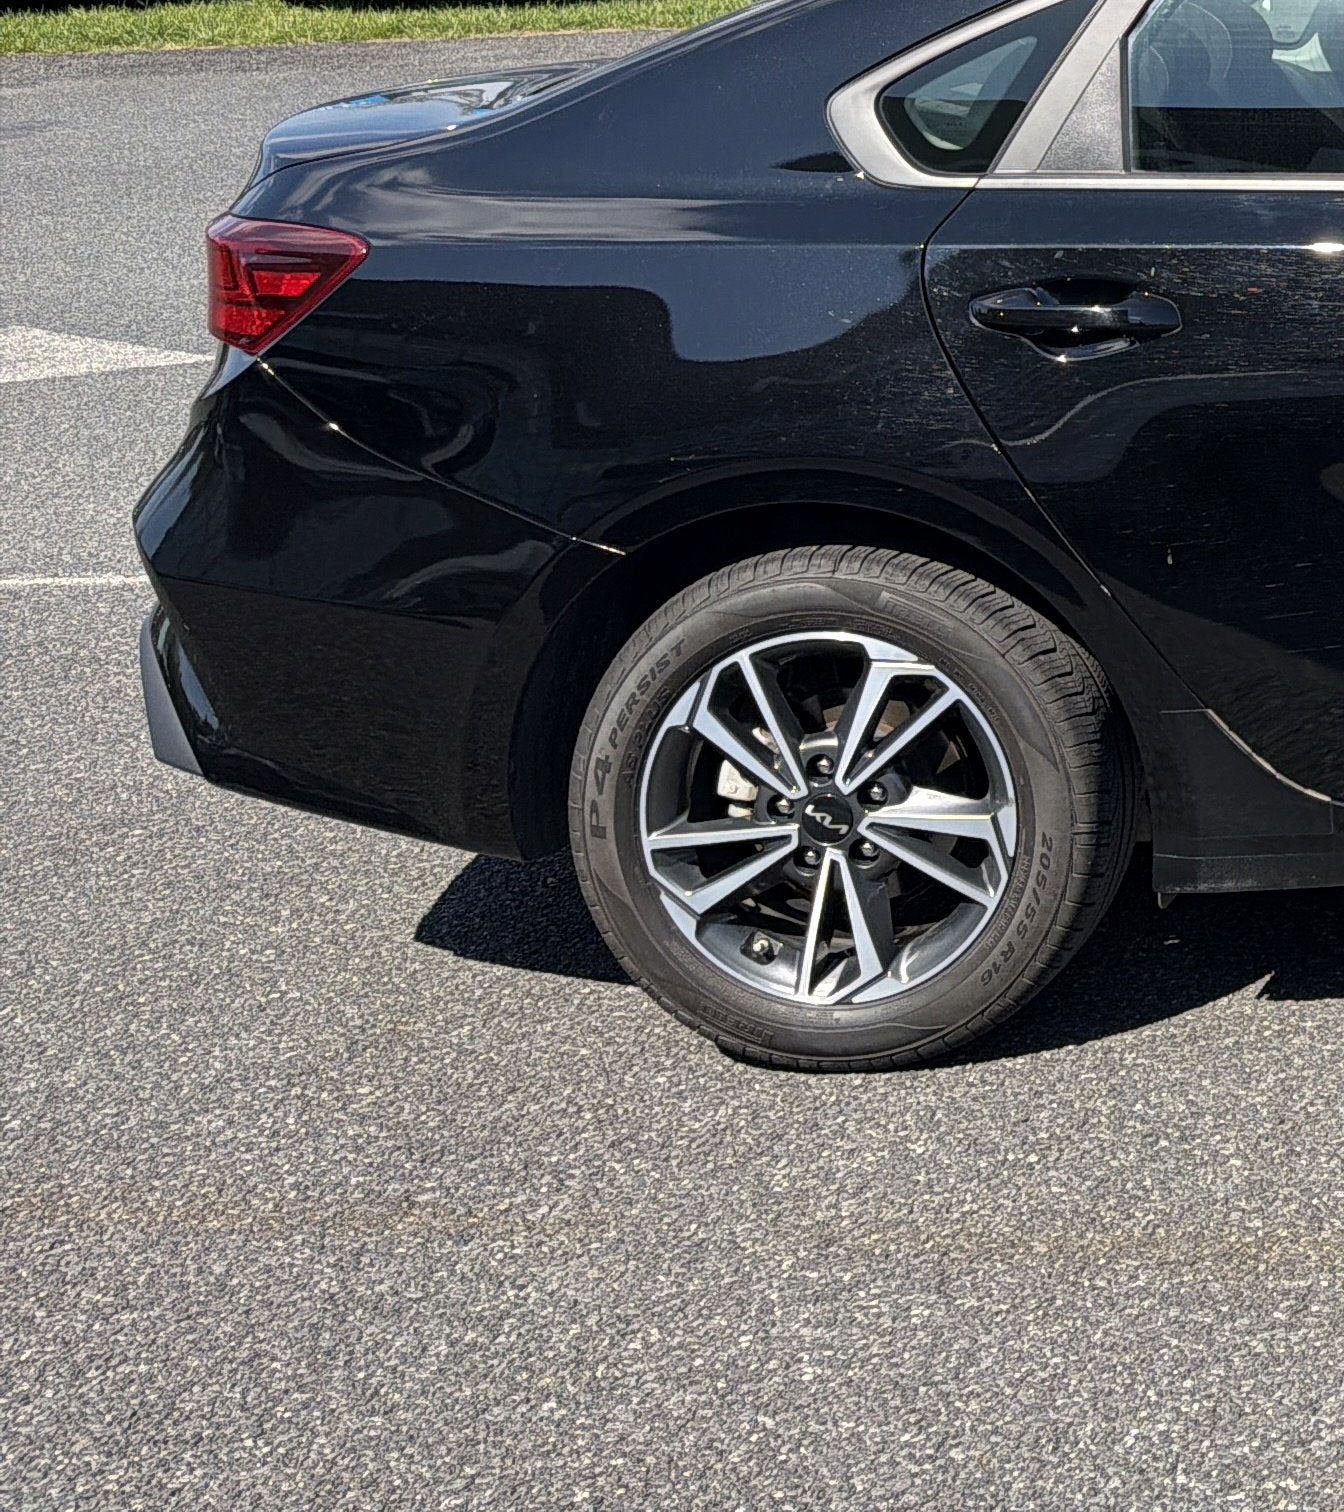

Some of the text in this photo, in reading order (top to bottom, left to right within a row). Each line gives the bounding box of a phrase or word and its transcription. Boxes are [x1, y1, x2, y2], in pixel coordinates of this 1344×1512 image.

[589, 637, 686, 839] P4 PERSIST
[804, 804, 850, 835] KIA
[1016, 831, 1053, 940] 205/55
[980, 940, 1016, 987] R16
